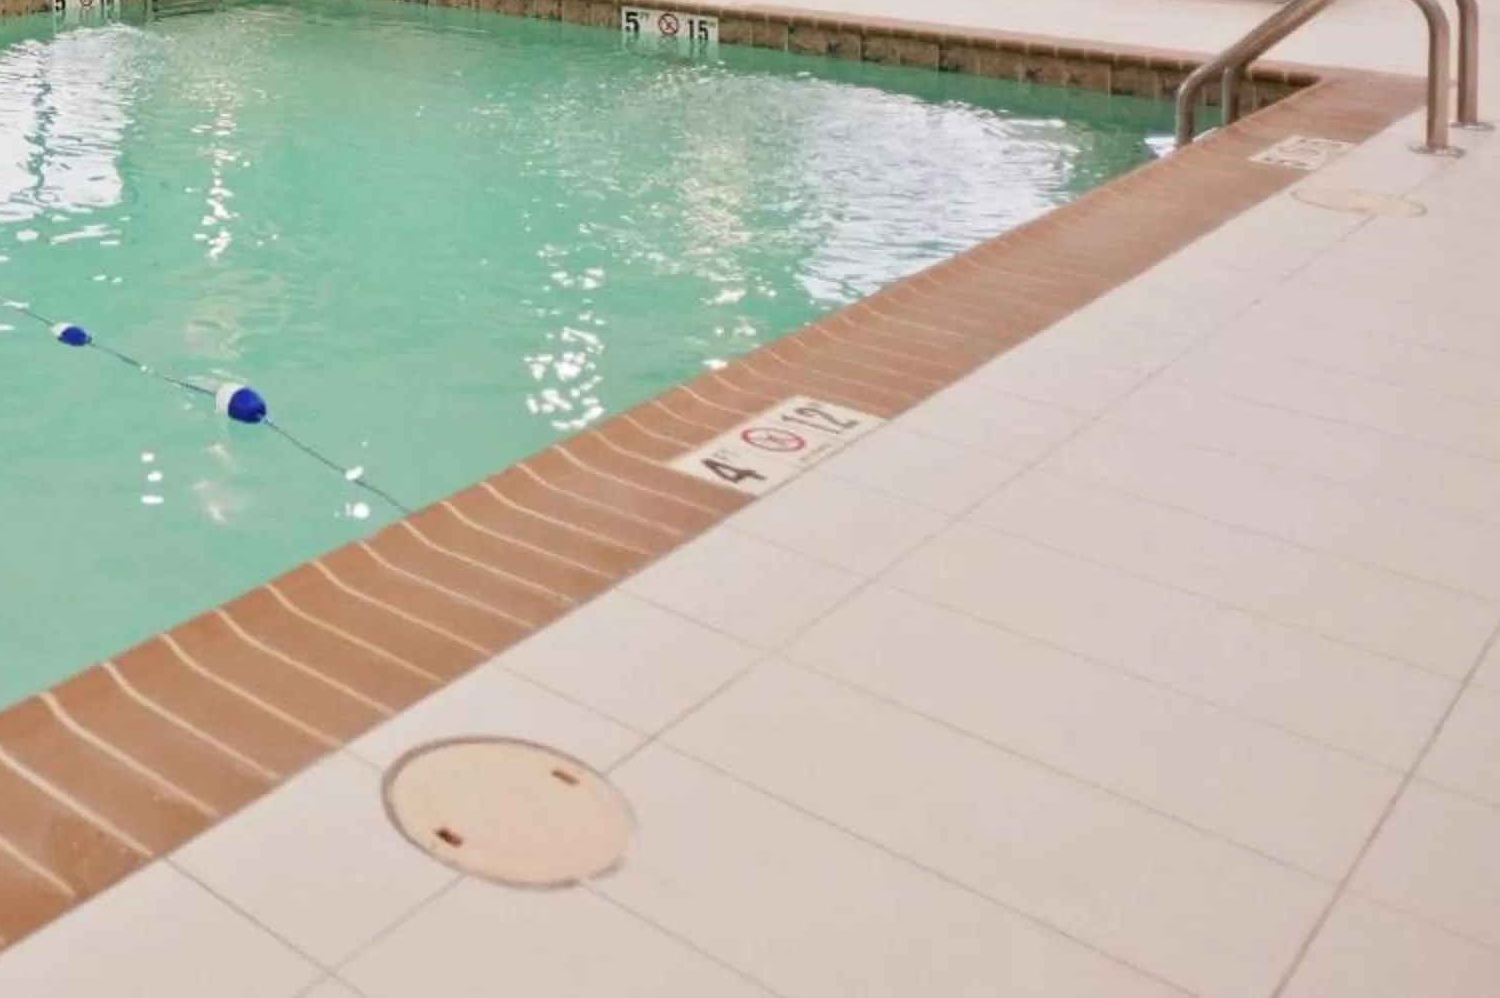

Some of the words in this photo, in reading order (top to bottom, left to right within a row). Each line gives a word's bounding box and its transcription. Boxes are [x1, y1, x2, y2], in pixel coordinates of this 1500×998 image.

[625, 11, 639, 32] 5
[687, 18, 709, 40] 15
[701, 457, 769, 484] 4
[780, 406, 861, 435] 12
